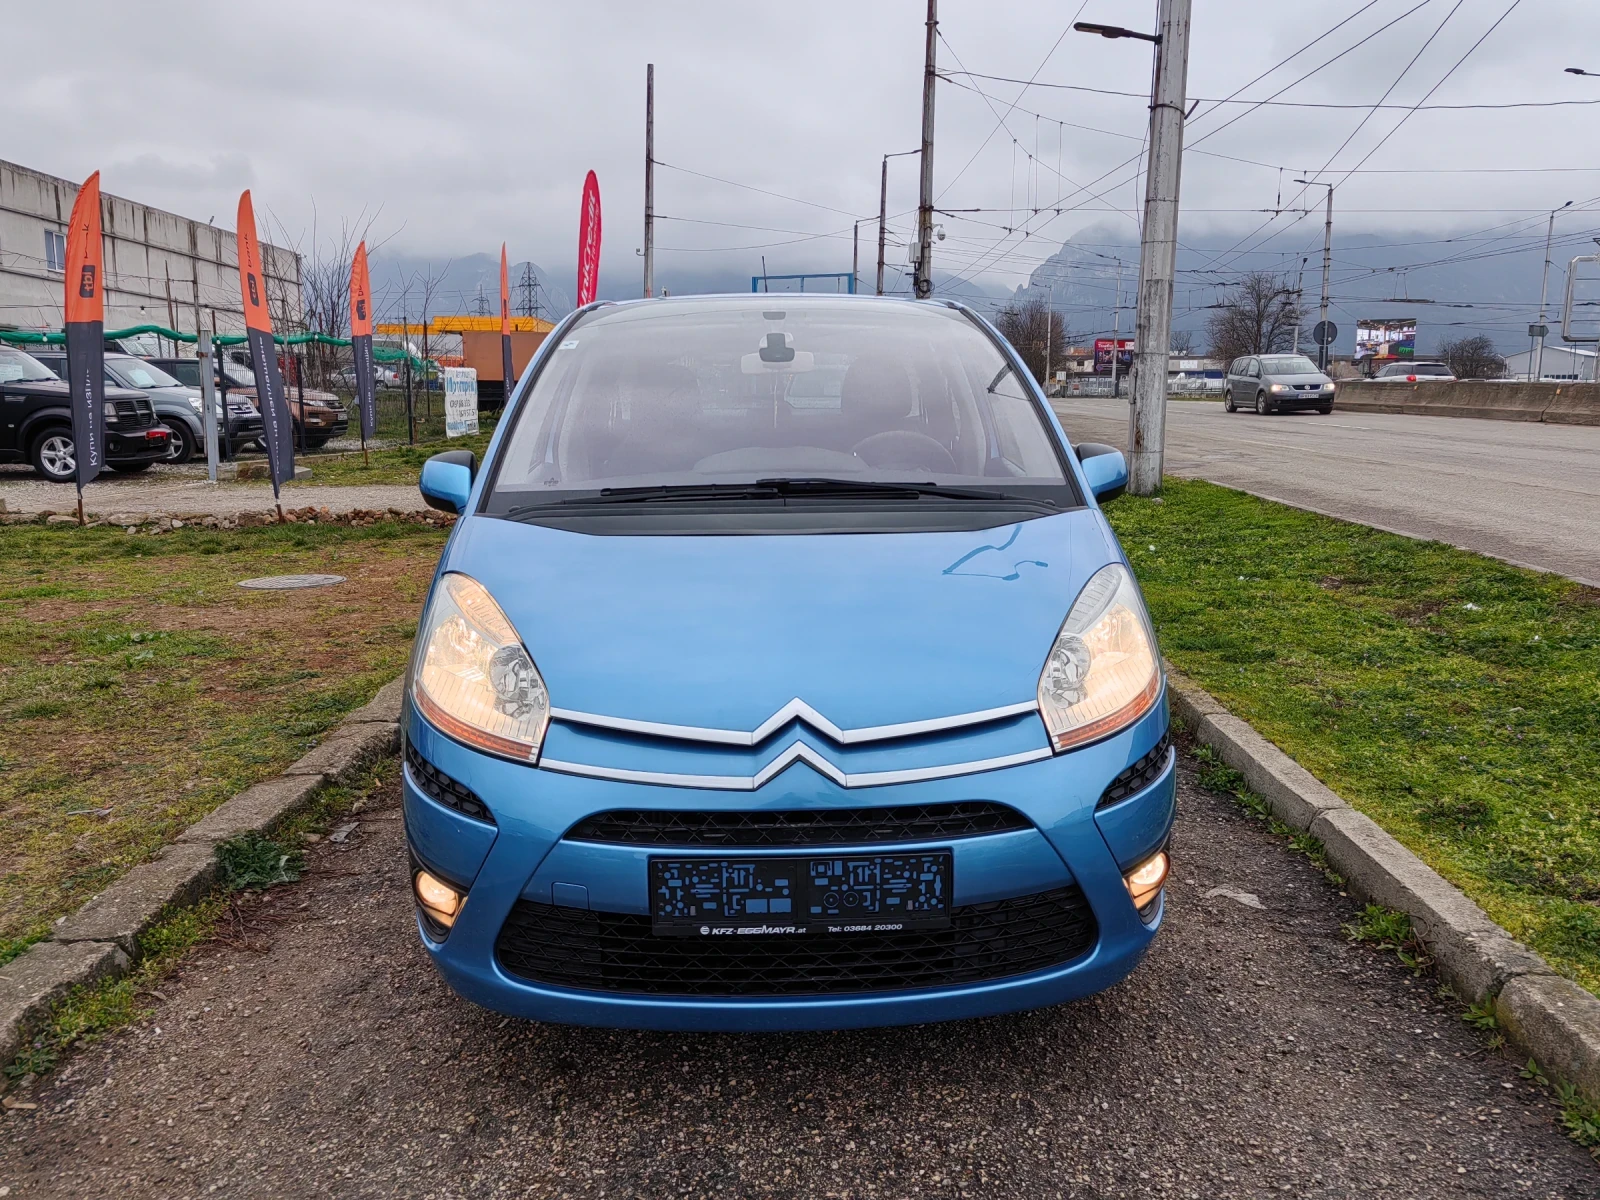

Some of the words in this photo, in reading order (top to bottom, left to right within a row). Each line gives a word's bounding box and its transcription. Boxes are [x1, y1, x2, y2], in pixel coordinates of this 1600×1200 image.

[82, 271, 94, 292] tbi
[88, 432, 98, 467] Купи
[874, 923, 903, 931] 20300
